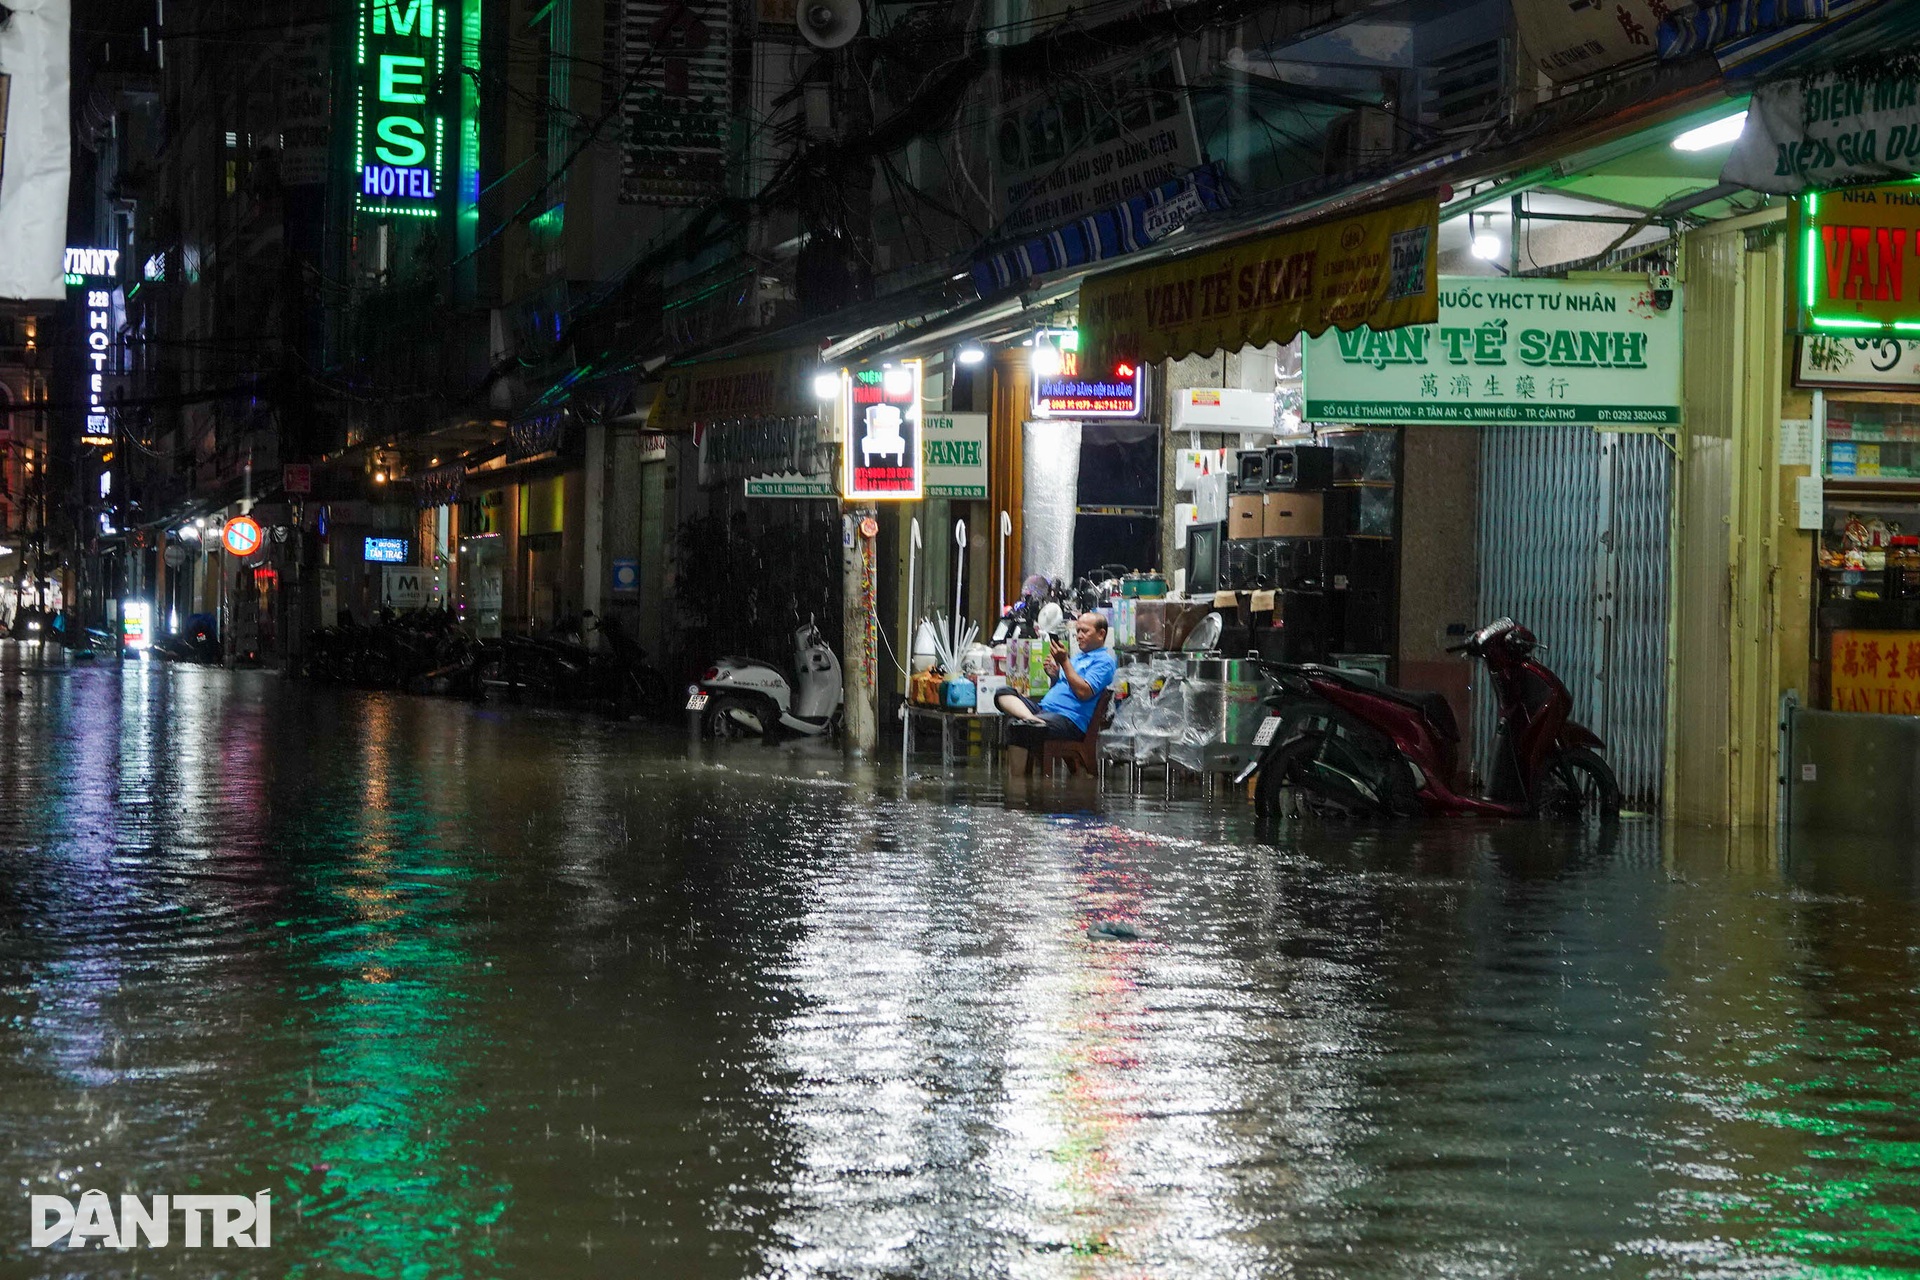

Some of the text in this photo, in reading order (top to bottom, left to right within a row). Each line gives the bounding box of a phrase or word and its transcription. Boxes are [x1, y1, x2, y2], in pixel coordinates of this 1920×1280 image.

[1092, 151, 1114, 176] SÚP
[1837, 129, 1876, 166] GIA
[364, 166, 435, 197] HOTEL
[1121, 175, 1142, 199] GIA
[1237, 249, 1319, 311] SANH
[1822, 225, 1906, 312] VẠN
[1489, 293, 1534, 311] YHCT
[1537, 292, 1560, 311] TƯ
[1565, 290, 1617, 313] NHÂN
[88, 310, 109, 412] HOTEL
[1334, 324, 1429, 370] VẠN
[1439, 318, 1508, 365] TẾ
[1519, 327, 1647, 368] SANH
[1323, 404, 1336, 417] SỐ
[1337, 406, 1349, 417] 04
[1350, 404, 1361, 418] LÊ
[1361, 404, 1389, 418] THÁNH
[1390, 405, 1411, 418] TÔN
[1426, 405, 1443, 419] TÂN
[1444, 407, 1457, 419] AN
[1474, 408, 1497, 419] NINH
[1497, 405, 1517, 420] KIỀU
[1538, 404, 1556, 421] CẦN
[1557, 406, 1576, 420] THƠ
[1598, 409, 1610, 421] ĐT:
[1612, 409, 1631, 421] 0292
[1632, 409, 1667, 421] 3820435
